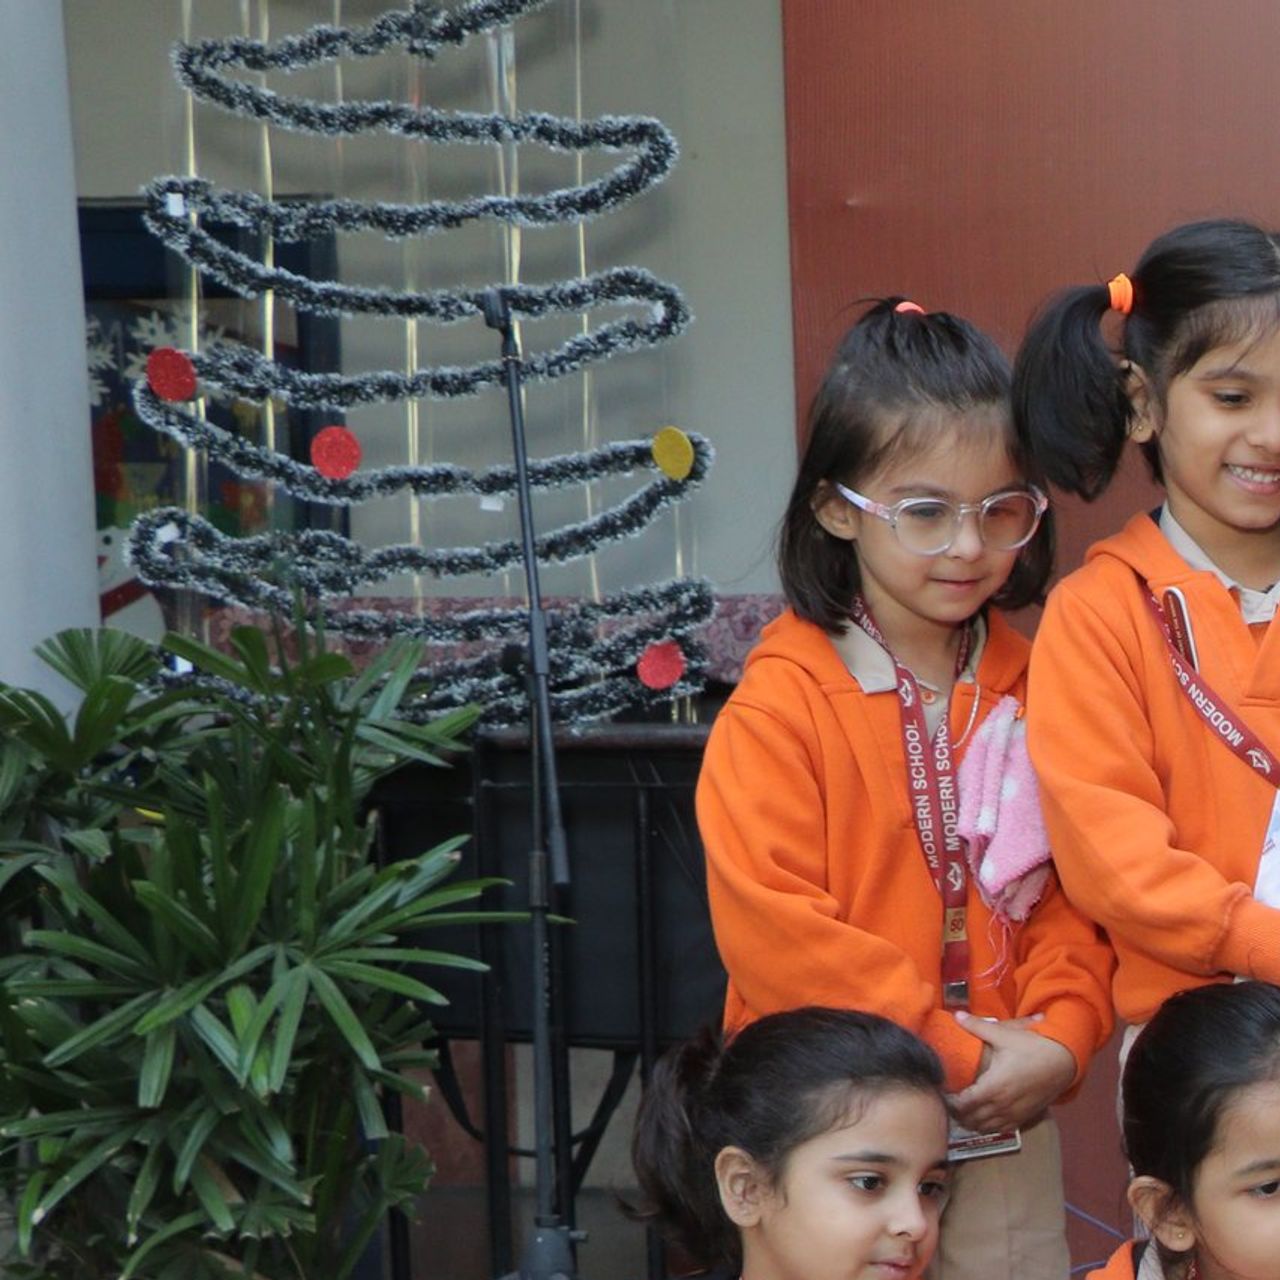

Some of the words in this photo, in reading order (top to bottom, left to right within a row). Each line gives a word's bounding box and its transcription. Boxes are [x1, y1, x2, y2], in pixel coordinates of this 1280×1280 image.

[1188, 680, 1245, 748] MODERN
[905, 720, 928, 790] SCHOOL
[914, 795, 942, 869] MODERN
[938, 775, 961, 852] MODERN
